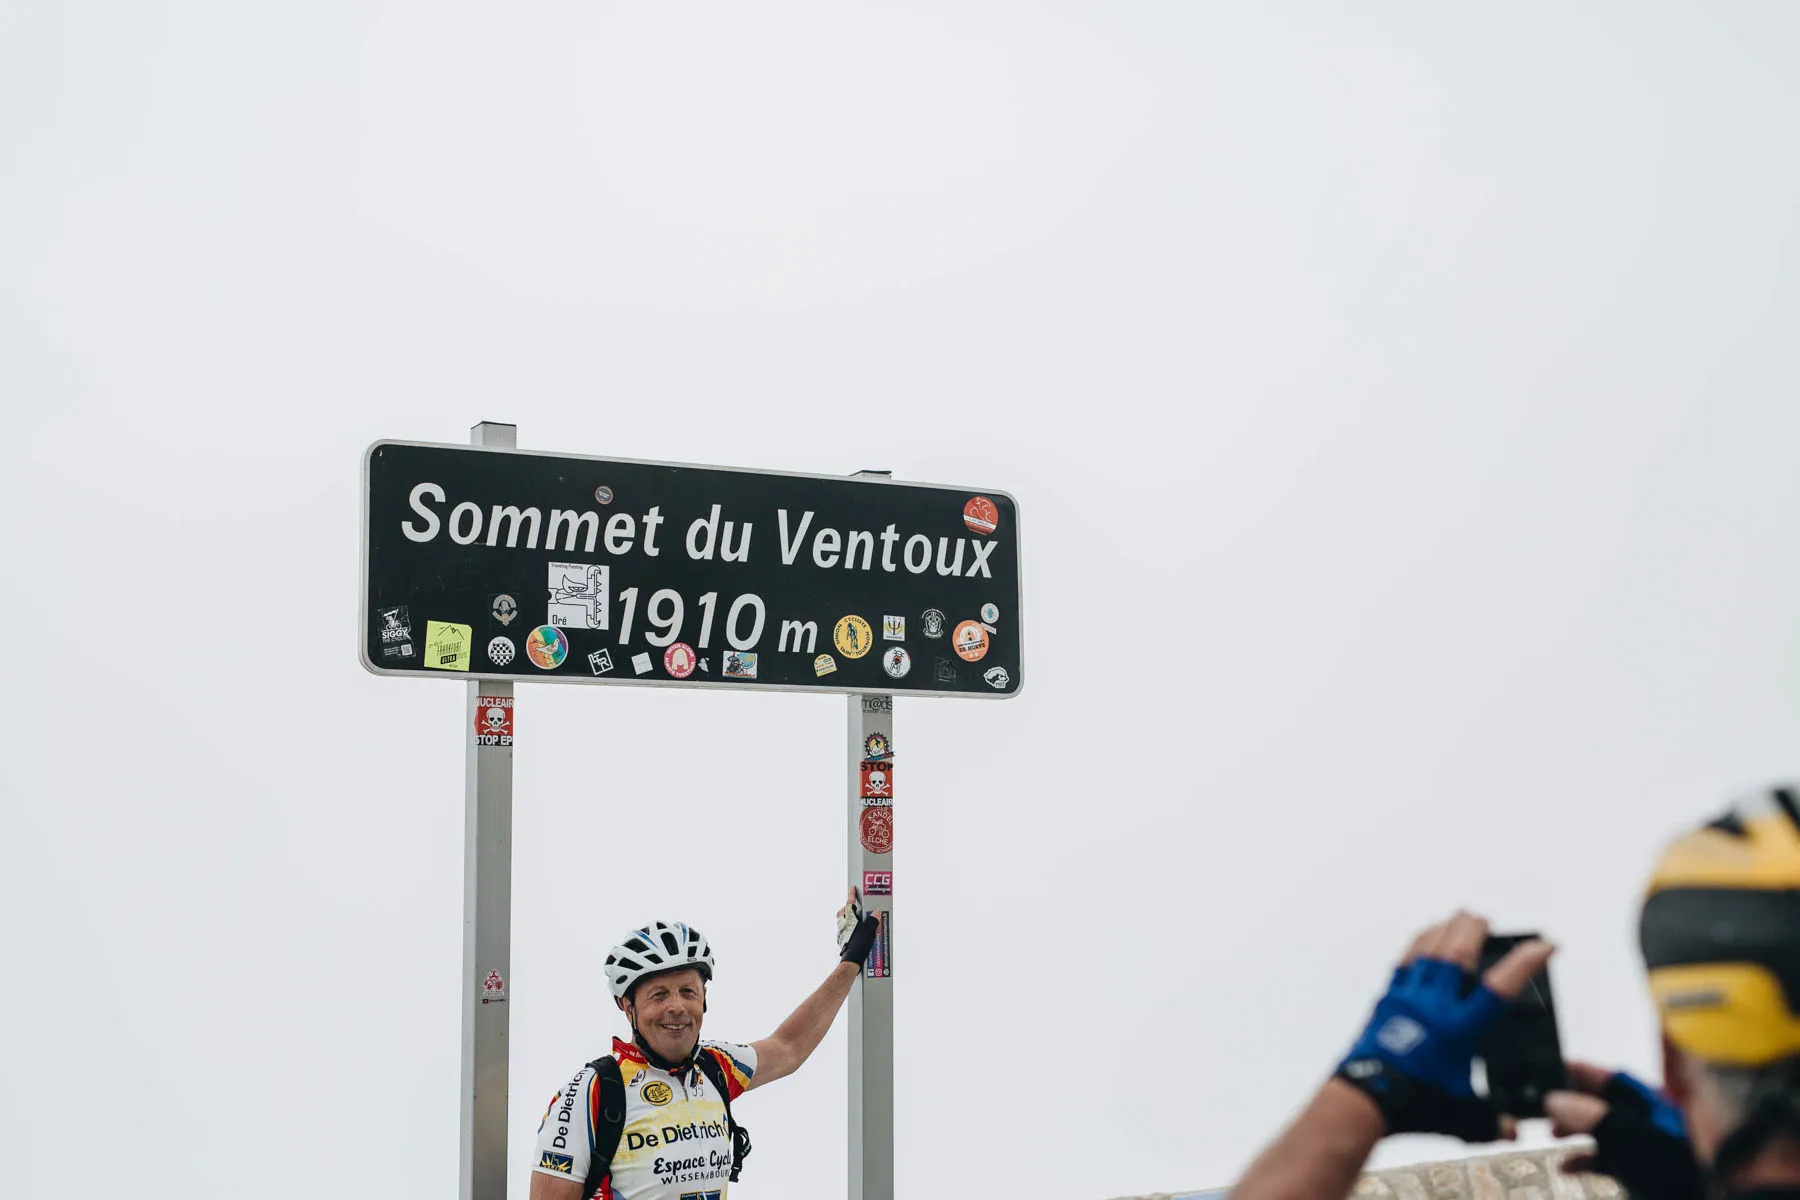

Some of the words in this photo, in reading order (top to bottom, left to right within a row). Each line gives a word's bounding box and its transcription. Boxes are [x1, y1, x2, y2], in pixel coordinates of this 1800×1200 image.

[401, 481, 664, 557] Sommet
[686, 503, 753, 564] du
[777, 508, 998, 579] Ventoux
[618, 587, 766, 652] 1910
[778, 619, 818, 654] m
[833, 623, 843, 645] UNION
[844, 617, 867, 629] CYCLISTE
[382, 629, 408, 639] SIGGY
[840, 646, 852, 656] TAIN
[855, 631, 871, 656] TOURNON
[476, 735, 498, 746] STOP
[860, 761, 893, 772] STOP
[865, 874, 891, 885] CCG
[552, 1126, 569, 1149] De
[627, 1133, 659, 1151] De
[662, 1120, 725, 1144] Dietrich
[653, 1155, 705, 1175] Espace
